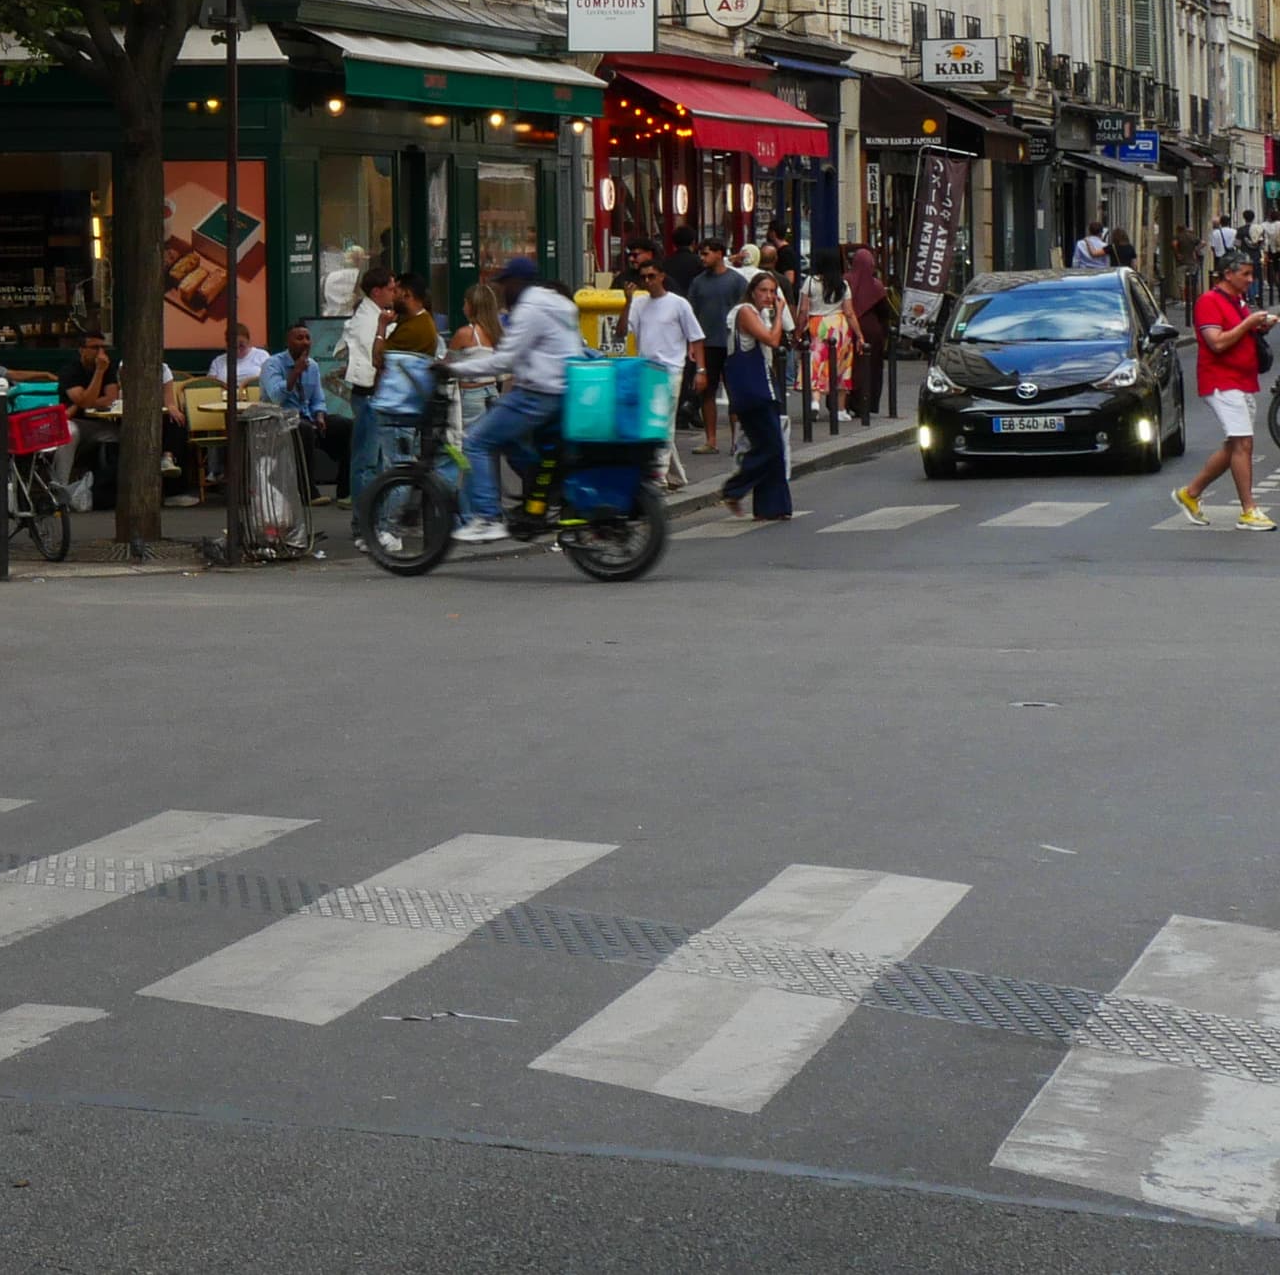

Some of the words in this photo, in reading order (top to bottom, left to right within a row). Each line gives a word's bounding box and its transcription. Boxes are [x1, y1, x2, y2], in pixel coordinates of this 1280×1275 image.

[1095, 118, 1123, 130] YOJI
[913, 221, 934, 284] RAMEN
[928, 225, 948, 287] CURRY
